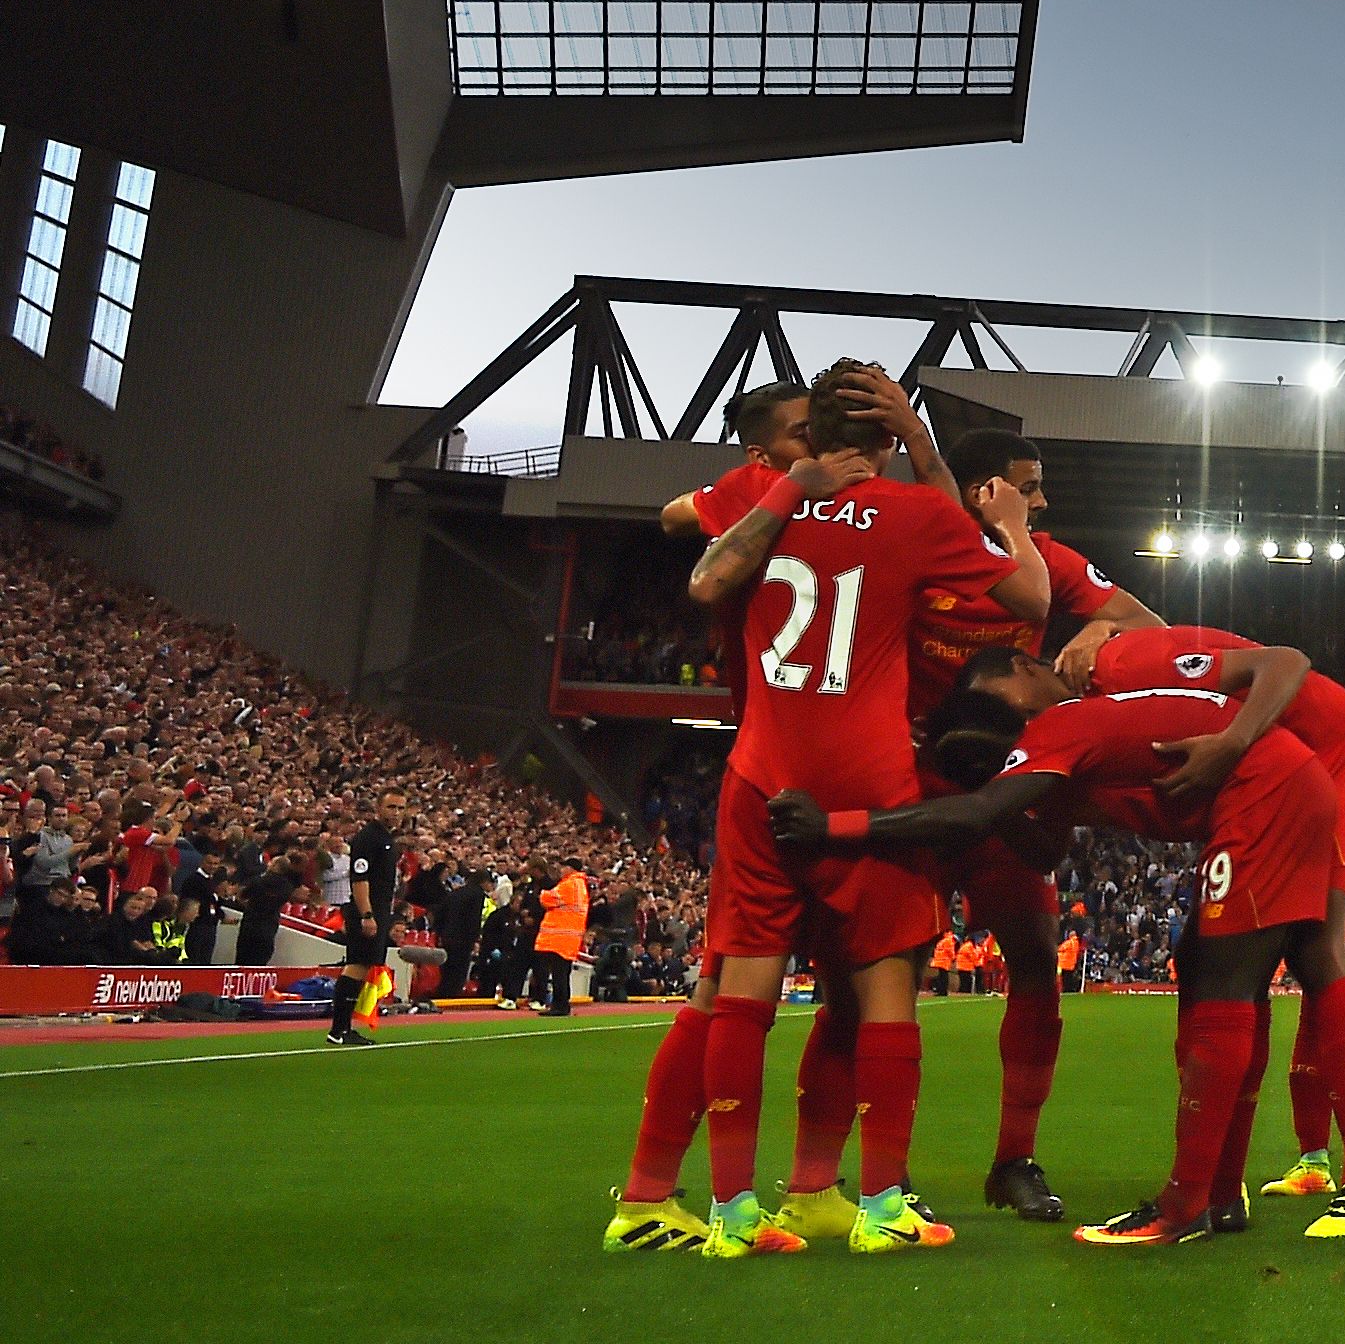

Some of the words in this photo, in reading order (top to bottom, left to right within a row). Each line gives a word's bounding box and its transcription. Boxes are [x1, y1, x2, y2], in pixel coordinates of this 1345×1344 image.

[793, 500, 878, 530] UCAS
[760, 555, 864, 694] 21
[115, 979, 139, 1003] new
[139, 974, 182, 1003] balance
